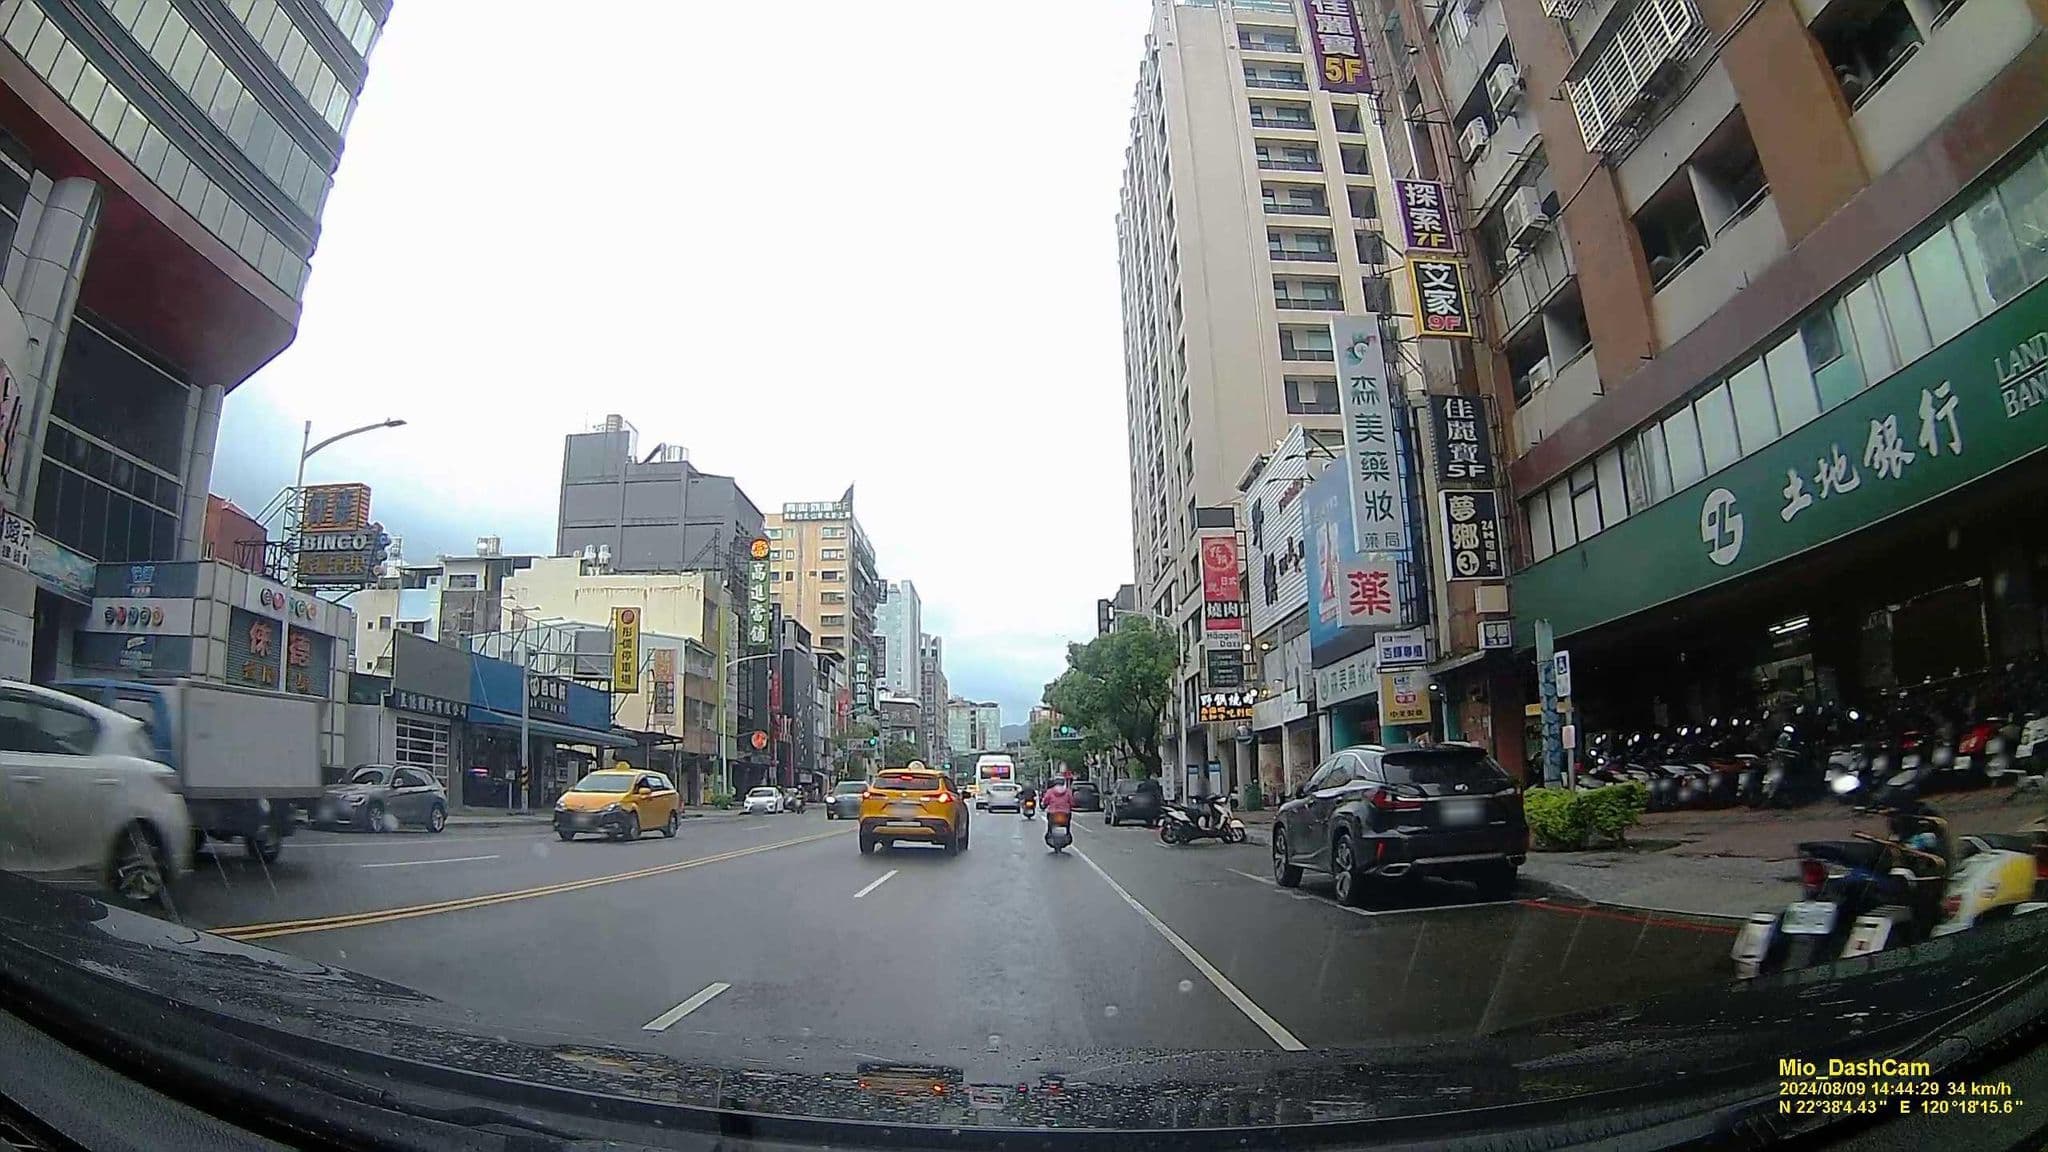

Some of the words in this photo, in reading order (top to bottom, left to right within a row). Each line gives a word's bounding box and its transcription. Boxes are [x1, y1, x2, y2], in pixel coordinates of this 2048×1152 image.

[1325, 57, 1363, 84] 5F
[1404, 183, 1442, 232] 探索
[1413, 232, 1446, 247] 7F
[1418, 262, 1459, 315] 艾家
[1427, 315, 1461, 331] 9F
[1350, 374, 1395, 523] 森美藥妝
[1442, 398, 1480, 464] 佳麗寶
[1780, 379, 1963, 523] 土地銀行
[1446, 464, 1487, 478] 5F
[1449, 495, 1479, 550] 夢鄉
[302, 535, 367, 551] BINGO
[104, 606, 164, 626] BINGO
